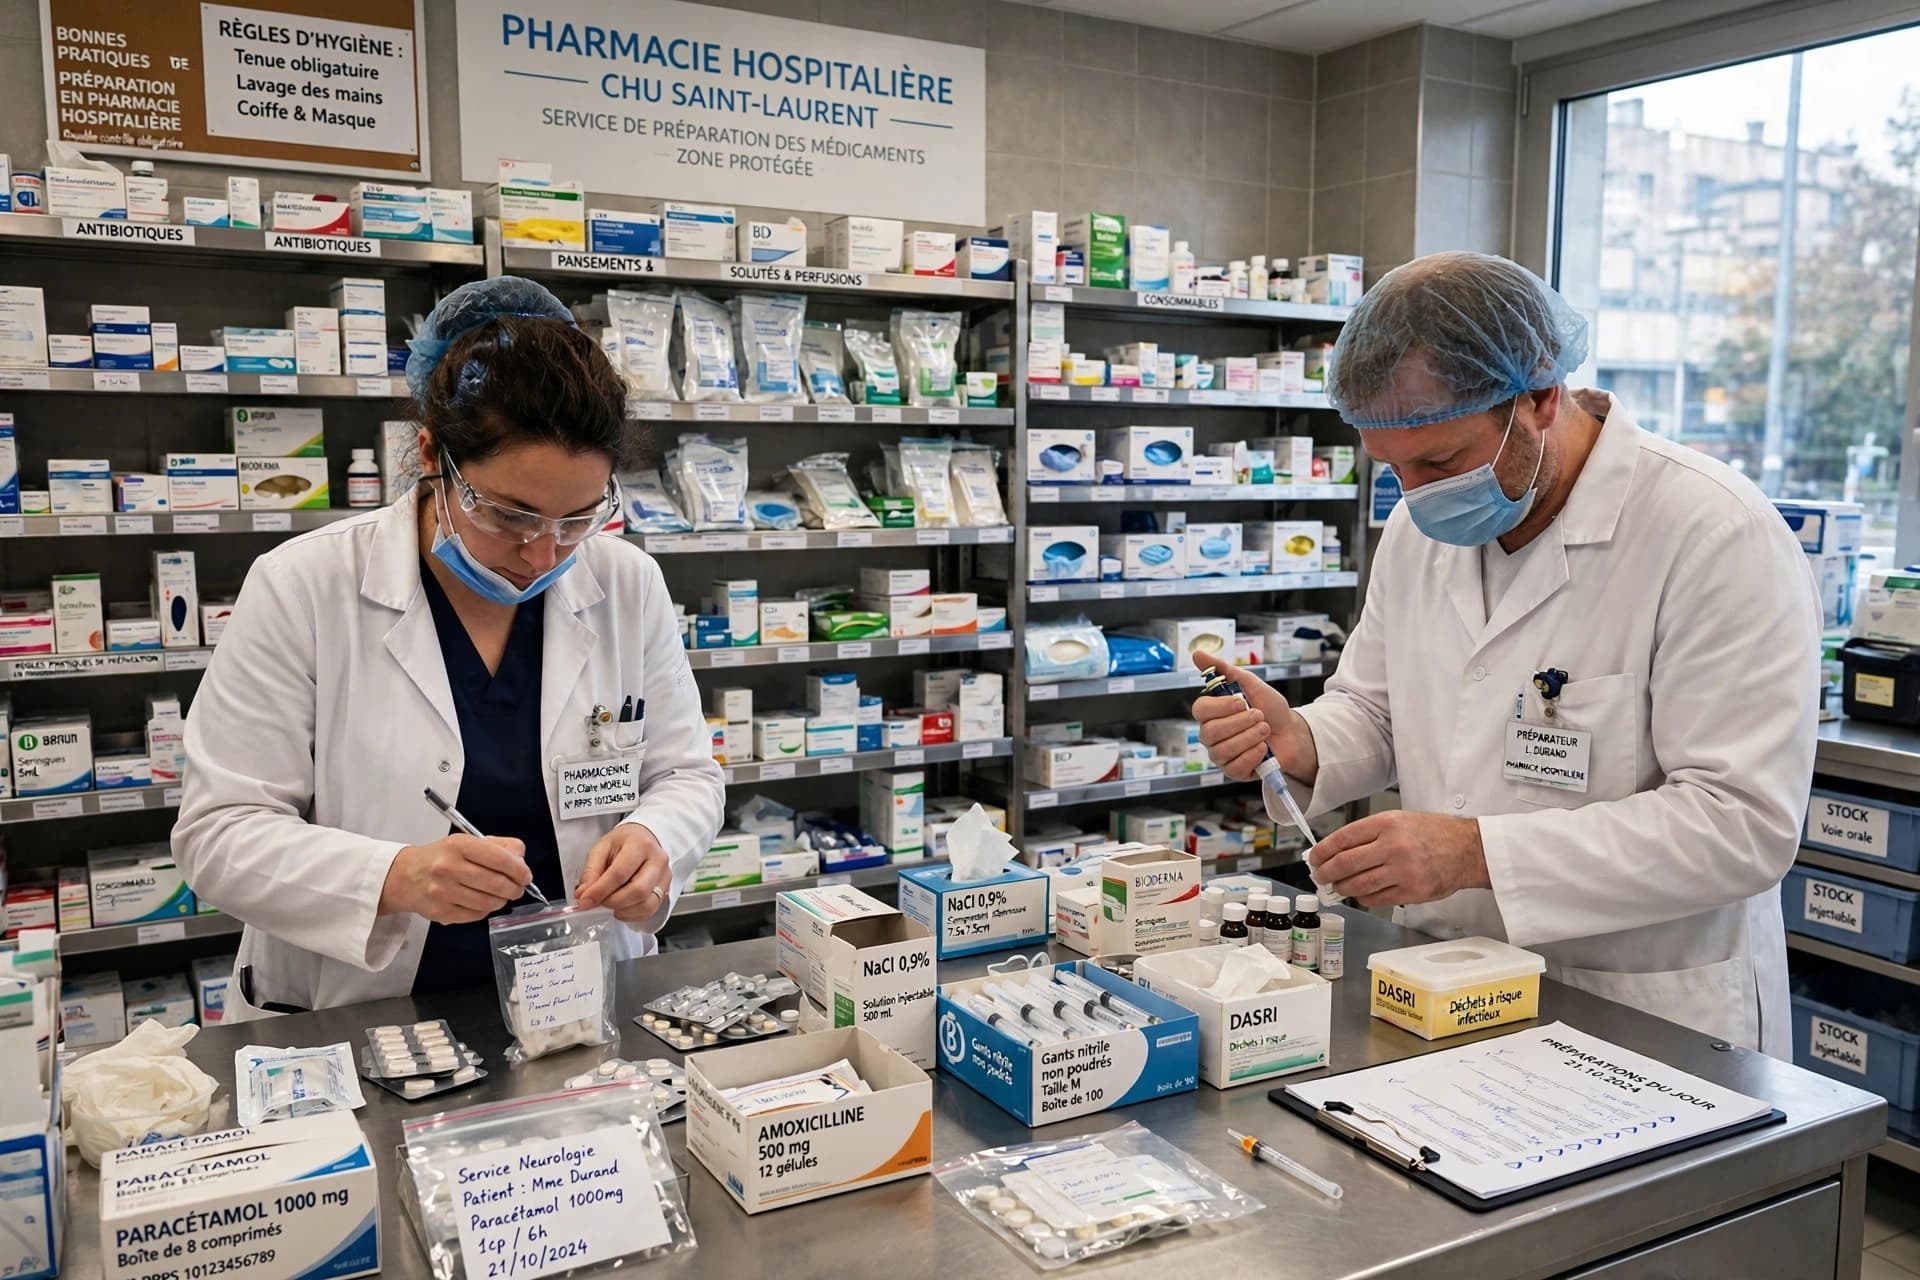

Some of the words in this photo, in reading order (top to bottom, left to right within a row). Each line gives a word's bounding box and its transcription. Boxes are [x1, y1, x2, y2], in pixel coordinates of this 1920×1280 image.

[56, 26, 127, 47] BONNES
[219, 18, 290, 44] RÈGLES
[296, 30, 393, 57] D'HYGIÈNE
[58, 45, 150, 68] PRATIQUES
[234, 48, 286, 69] Tenue
[502, 14, 721, 73] PHARMACIE
[733, 49, 953, 104] HOSPITALIÈRE
[60, 69, 175, 95] PRÉPARATION
[236, 74, 296, 97] Lavage
[301, 81, 330, 99] des
[335, 88, 383, 105] mains
[60, 90, 83, 105] EN
[88, 92, 180, 114] PHARMACIE
[601, 73, 663, 102] CHU
[671, 80, 878, 129] SAINT-LAURENT
[61, 108, 182, 131] HOSPITALIÈRE
[237, 100, 288, 119] Coiffe
[293, 105, 306, 122] &
[312, 107, 376, 130] Masque
[542, 107, 618, 132] SERVICE
[623, 116, 647, 136] DE
[653, 119, 770, 150] PRÉPARATION
[775, 136, 806, 154] DES
[811, 137, 926, 165] MÉDICAMENTS
[676, 148, 724, 168] ZONE
[730, 153, 814, 177] PROTÉGÉE
[76, 223, 184, 242] ANTIBIOTIQUES
[274, 236, 372, 253] ANTIBIOTIQUES
[753, 225, 772, 239] BD
[558, 255, 642, 272] PANSEMENTS
[645, 260, 654, 272] &
[730, 265, 780, 281] SOLUTÉS
[784, 269, 792, 282] &
[795, 270, 863, 286] PERFUSIONS
[1516, 729, 1578, 747] PRÉPARATEUR
[1533, 746, 1567, 758] DURAND
[1827, 803, 1868, 823] STOCK
[1821, 822, 1843, 839] Voie
[1846, 827, 1873, 844] orale
[1135, 872, 1183, 887] BIODERMA
[948, 894, 975, 912] NaCl
[978, 889, 1007, 908] 0,9%
[1813, 883, 1854, 905] STOCK
[864, 956, 894, 977] NaCl
[899, 951, 930, 973] 0,9%
[863, 995, 896, 1010] Solution
[898, 987, 934, 1005] injectable
[1378, 980, 1415, 1008] DASRI
[1450, 995, 1486, 1014] Déchets
[1489, 992, 1494, 1006] à
[1496, 988, 1522, 1005] risque
[863, 1010, 878, 1021] 500
[1230, 1006, 1277, 1031] DASRI
[1457, 1007, 1501, 1026] infectieux
[1818, 1021, 1858, 1045] STOCK
[1041, 1047, 1076, 1065] Gants
[1077, 1039, 1110, 1056] nitrile
[1041, 1067, 1064, 1082] non
[1067, 1056, 1112, 1077] poudrés
[1541, 1037, 1647, 1083] PRÉPARATIONS
[1645, 1080, 1672, 1093] DU
[1670, 1092, 1716, 1111] JOUR
[1041, 1079, 1068, 1097] Taille
[1070, 1077, 1081, 1092] M
[1070, 1090, 1083, 1104] de
[1085, 1088, 1104, 1102] 100
[758, 1106, 865, 1142] AMOXICILLINE
[115, 1128, 256, 1159] PARACÉTAMOL
[759, 1143, 784, 1161] 500
[789, 1138, 811, 1155] mg
[116, 1153, 271, 1189] PARACÉTAMOL
[458, 1163, 510, 1184] Service
[519, 1145, 596, 1172] Neurologie
[759, 1164, 772, 1178] 12
[776, 1154, 818, 1178] gélules
[463, 1182, 514, 1207] Patient
[532, 1177, 564, 1193] Mme
[570, 1160, 619, 1184] Durand
[115, 1203, 268, 1247] PARACÉTAMOL
[274, 1191, 317, 1215] 1000
[322, 1186, 349, 1206] mg
[471, 1197, 559, 1231] Paracétamol
[569, 1187, 624, 1208] 1000mg
[117, 1249, 159, 1268] Boîte
[163, 1242, 182, 1258] de
[187, 1239, 197, 1254] 8
[201, 1222, 282, 1248] comprimés
[479, 1236, 505, 1255] 1cp
[528, 1226, 547, 1242] 6h
[184, 1249, 276, 1280] 10123456789
[488, 1238, 588, 1278] 21/10/2024
